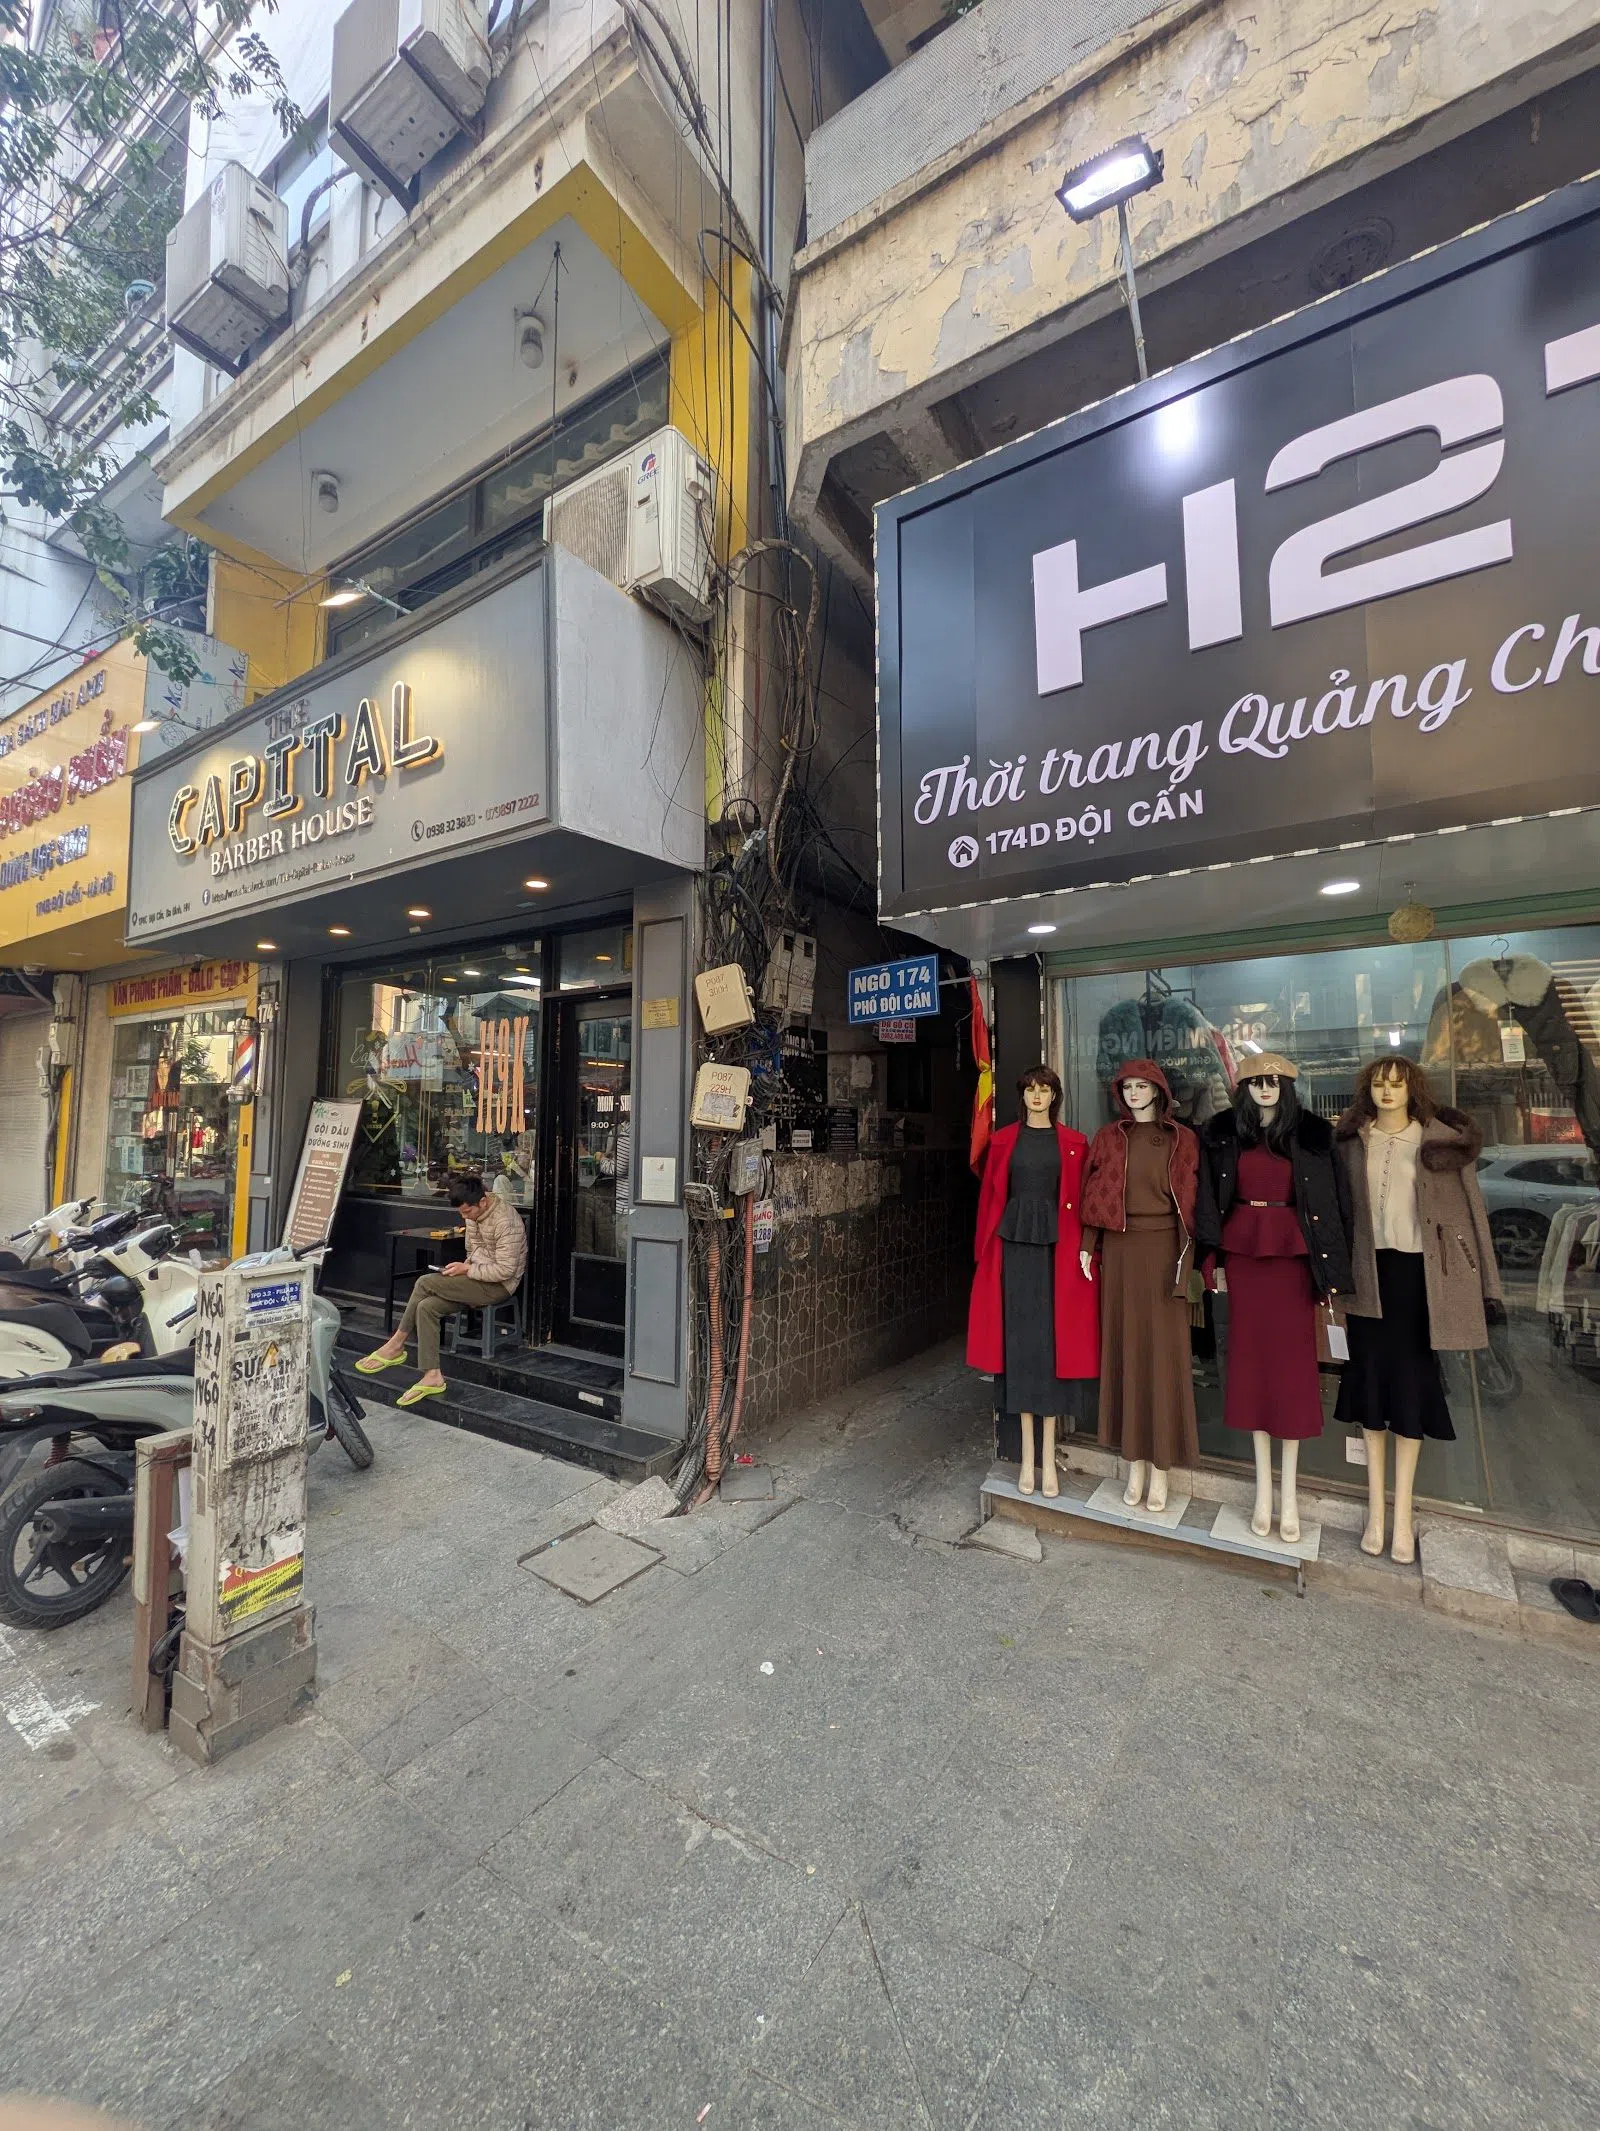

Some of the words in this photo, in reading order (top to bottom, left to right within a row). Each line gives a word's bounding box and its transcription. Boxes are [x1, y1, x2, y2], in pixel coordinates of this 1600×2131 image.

[265, 699, 310, 740] THE
[914, 754, 1027, 825] Thời
[1040, 719, 1209, 786] trang
[1218, 657, 1473, 759] Quảng
[168, 681, 440, 854] CAPITAL
[210, 828, 282, 877] BARBER
[291, 795, 374, 850] HOUSE
[985, 822, 1050, 855] 174D
[1055, 804, 1112, 844] ĐỘI
[1127, 784, 1204, 827] CẤN
[705, 973, 726, 988] P087
[854, 967, 891, 994] NGÕ
[896, 965, 931, 988] 174
[853, 994, 878, 1017] PHỐ
[880, 993, 901, 1015] ĐỘI
[904, 987, 932, 1010] CẤN
[711, 1071, 734, 1083] P087
[597, 1095, 614, 1112] MON
[620, 1095, 631, 1112] SU
[590, 1121, 609, 1129] 9:00
[332, 1140, 350, 1150] SINH
[200, 1283, 224, 1324] NGÕ
[195, 1370, 220, 1408] NGÕ
